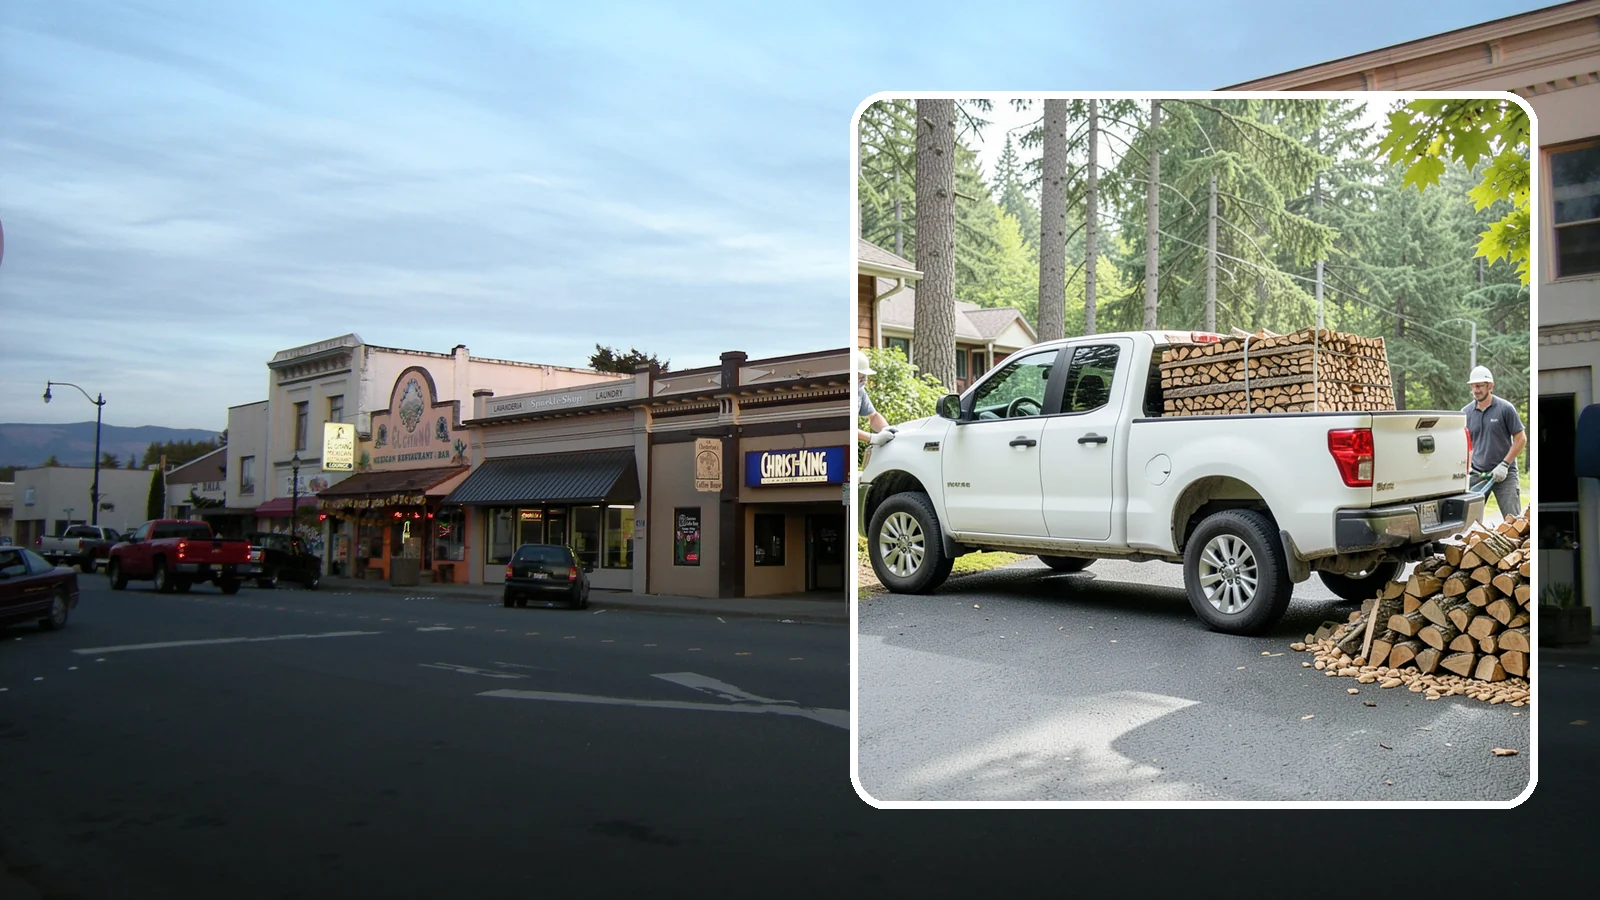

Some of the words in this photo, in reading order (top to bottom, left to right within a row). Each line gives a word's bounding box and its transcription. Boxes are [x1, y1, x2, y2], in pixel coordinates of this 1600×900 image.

[596, 388, 624, 400] LAUNDRY
[493, 401, 523, 413] LAVANDERIA
[531, 397, 561, 409] Sparkle
[562, 394, 582, 404] Shop
[374, 455, 396, 464] MEXICAN
[397, 451, 433, 462] RESTAURANT
[438, 450, 450, 459] BAR
[760, 452, 797, 478] CHRIST
[799, 450, 827, 476] KING
[696, 481, 709, 489] Coffee
